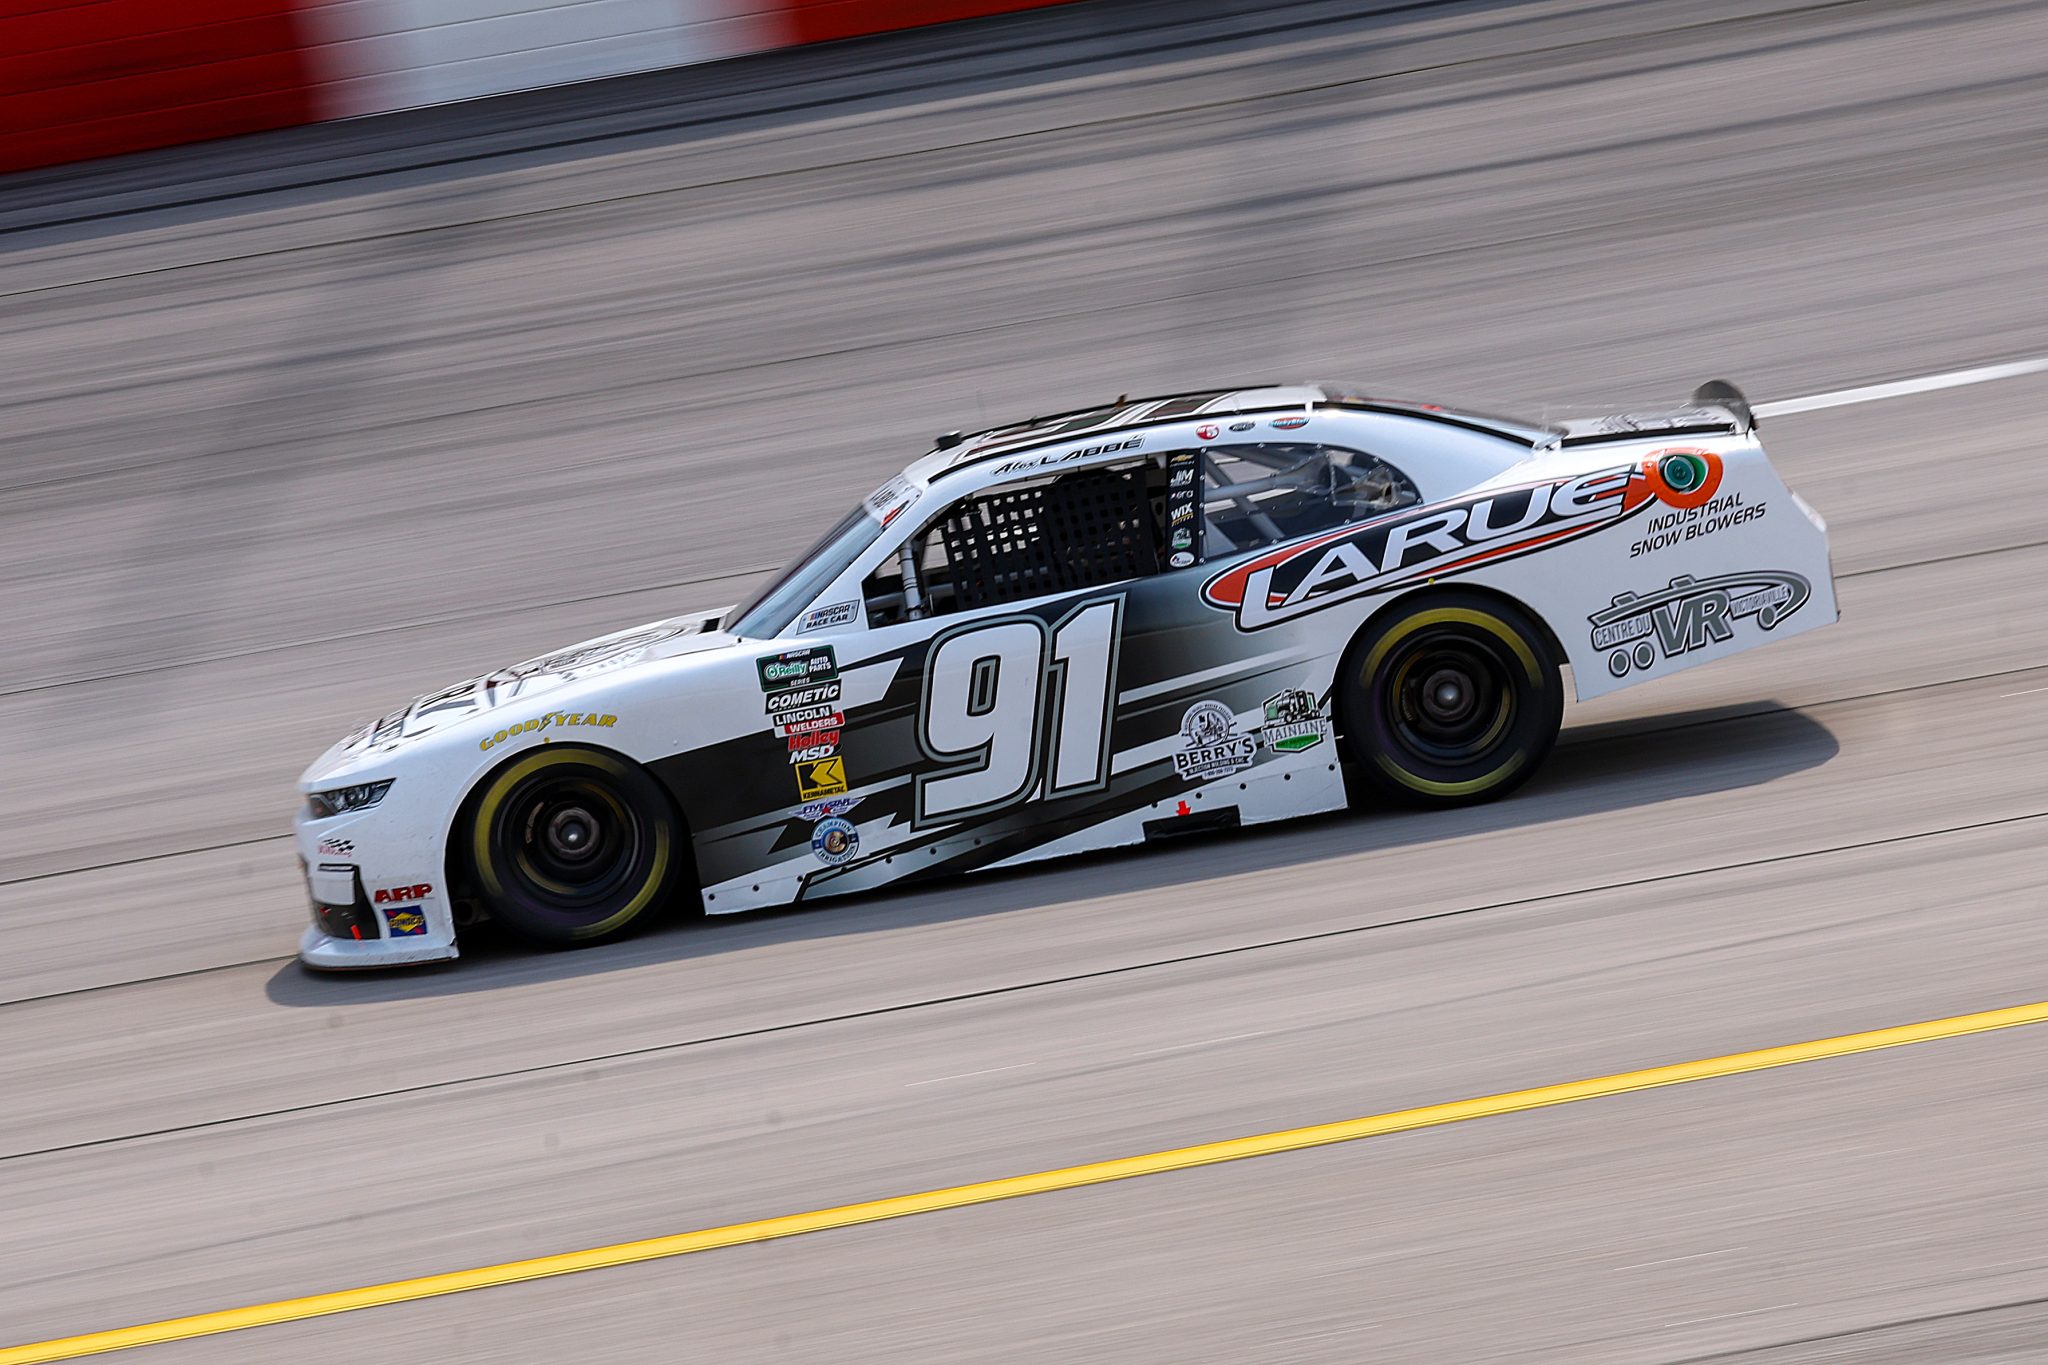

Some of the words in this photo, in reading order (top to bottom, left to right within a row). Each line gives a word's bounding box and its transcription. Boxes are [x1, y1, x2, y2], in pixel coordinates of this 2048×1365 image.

[1171, 502, 1193, 520] WIX
[1647, 492, 1744, 535] INDUSTRIAL
[1630, 530, 1683, 558] SNOW
[1685, 502, 1767, 541] BLOWERS
[1238, 463, 1637, 630] LARUE
[806, 617, 828, 629] RACE
[830, 614, 848, 624] CAR
[817, 605, 850, 619] NASCAR
[1652, 590, 1733, 658] VR
[1594, 617, 1636, 647] CENTRE
[1636, 614, 1651, 633] DU
[809, 662, 832, 673] PARTS
[810, 656, 829, 665] AUTO
[768, 684, 840, 710] COMETIC
[775, 706, 830, 726] LINCOLN
[915, 592, 1126, 827] 91
[479, 709, 618, 752] GOODYEAR
[790, 717, 838, 733] WELDERS
[1264, 719, 1327, 745] MAINLINE
[788, 730, 840, 751] Holley
[789, 744, 835, 764] MSD
[1176, 737, 1255, 770] BERRY'S
[374, 883, 433, 905] ARP
